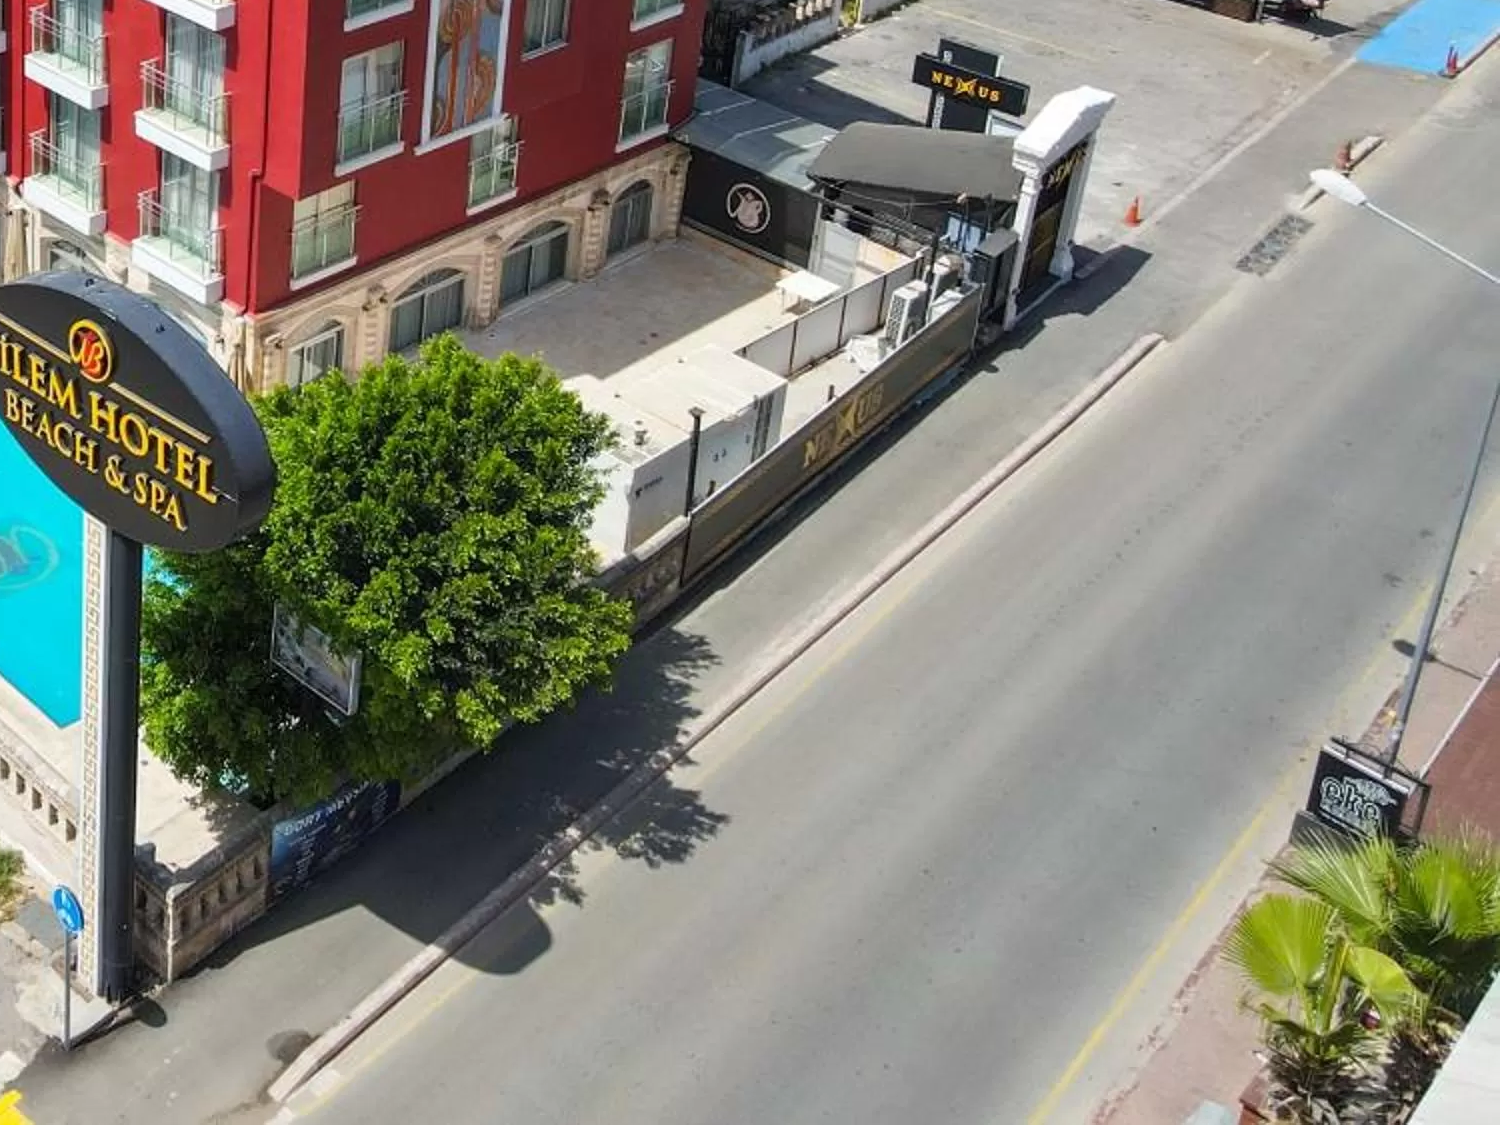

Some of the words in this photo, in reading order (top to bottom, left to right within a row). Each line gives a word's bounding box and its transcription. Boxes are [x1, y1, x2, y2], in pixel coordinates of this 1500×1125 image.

[931, 70, 1001, 103] NEXUS
[5, 388, 99, 474] BEACH
[105, 454, 130, 494] &
[134, 472, 188, 532] SPA
[89, 391, 218, 503] HOTEL
